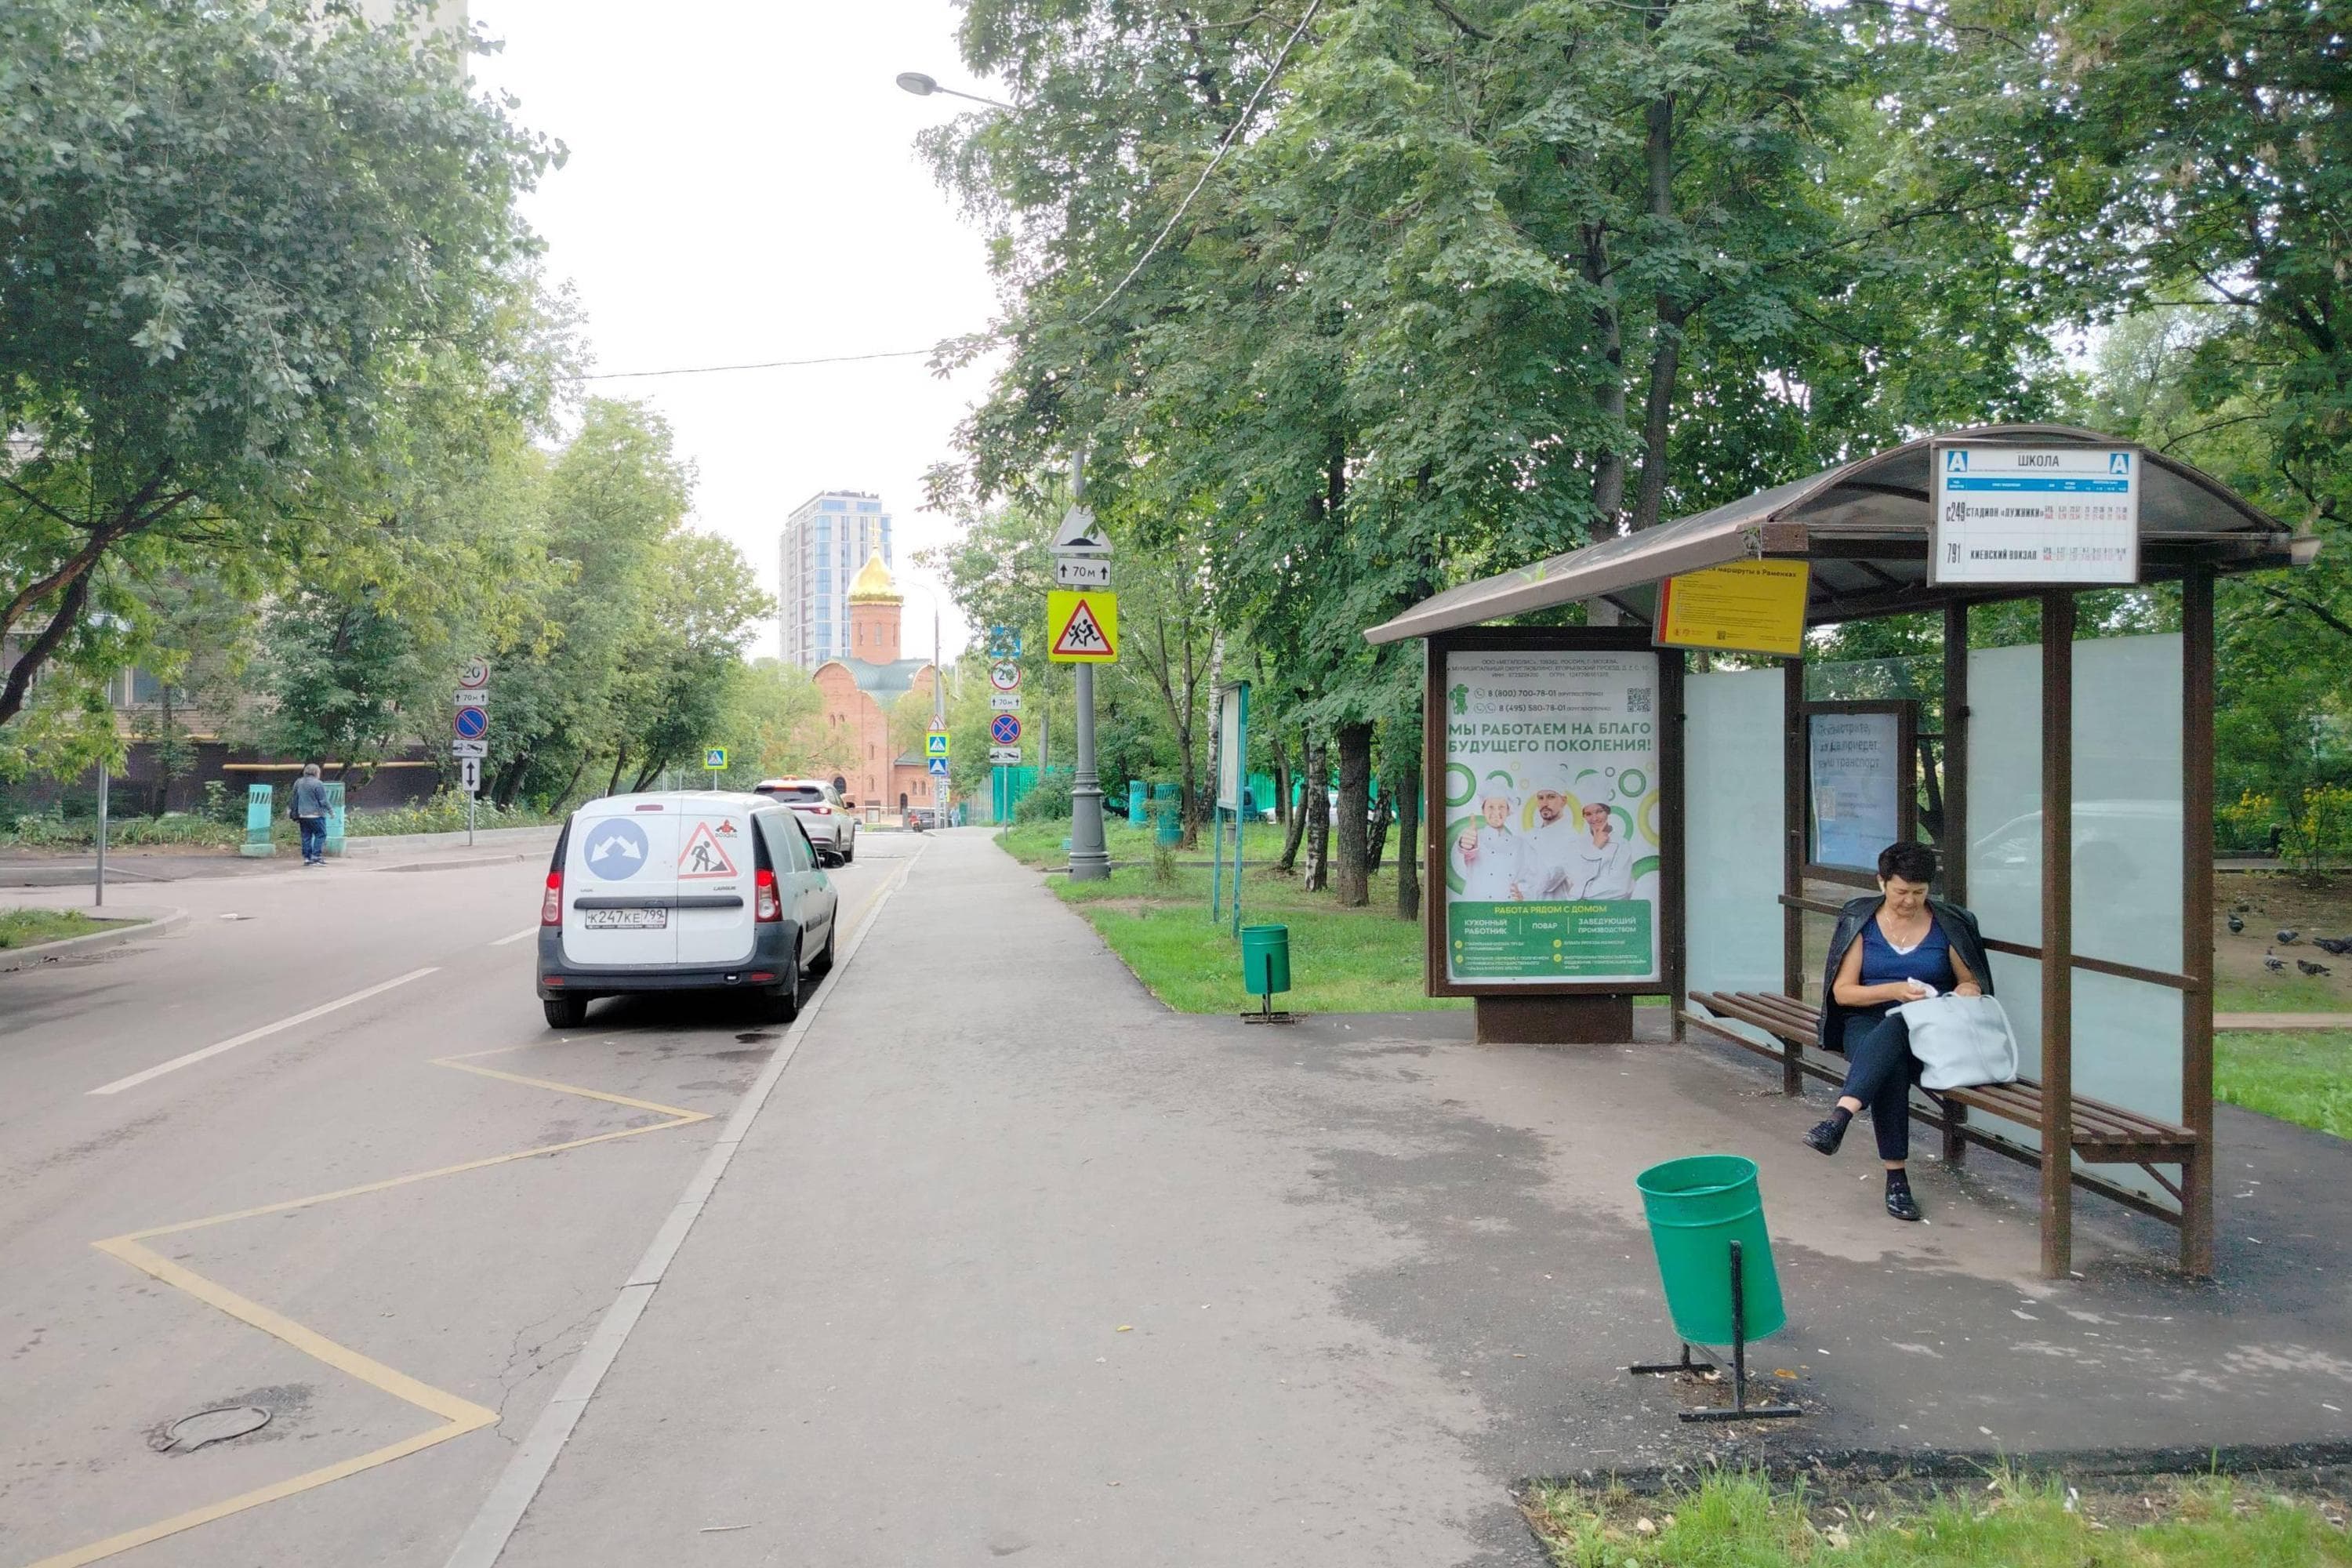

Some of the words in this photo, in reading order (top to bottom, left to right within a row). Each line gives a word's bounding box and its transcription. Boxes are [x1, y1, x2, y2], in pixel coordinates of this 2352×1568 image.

[2017, 455, 2060, 467] ШКОЛА
[1965, 507, 1998, 518] СТАДИОН
[2000, 507, 2044, 518] «ЛУЖНИКИ»
[1947, 543, 1961, 564] 791
[1970, 549, 2007, 561] КИЕВСКИЙ
[2009, 550, 2037, 561] ВОКЗАЛ
[1717, 567, 1755, 576] маршруты
[1762, 568, 1797, 579] Раменках
[463, 666, 481, 678] 20
[1494, 689, 1516, 698] (800)
[1505, 704, 1526, 713] (495)
[1449, 723, 1476, 735] МЫ
[1482, 723, 1566, 735] РАБОТАЕМ
[1572, 723, 1593, 735] НА
[1599, 722, 1651, 734] БЛАГО
[1449, 739, 1539, 753] БУДУЩЕГО
[1544, 739, 1651, 752] ПОКОЛЕНИЯ!
[1837, 758, 1879, 770] транспорт
[1465, 918, 1508, 927] КУХОННЫЙ
[1578, 916, 1636, 926] ЗАВЕДУЮЩИЙ
